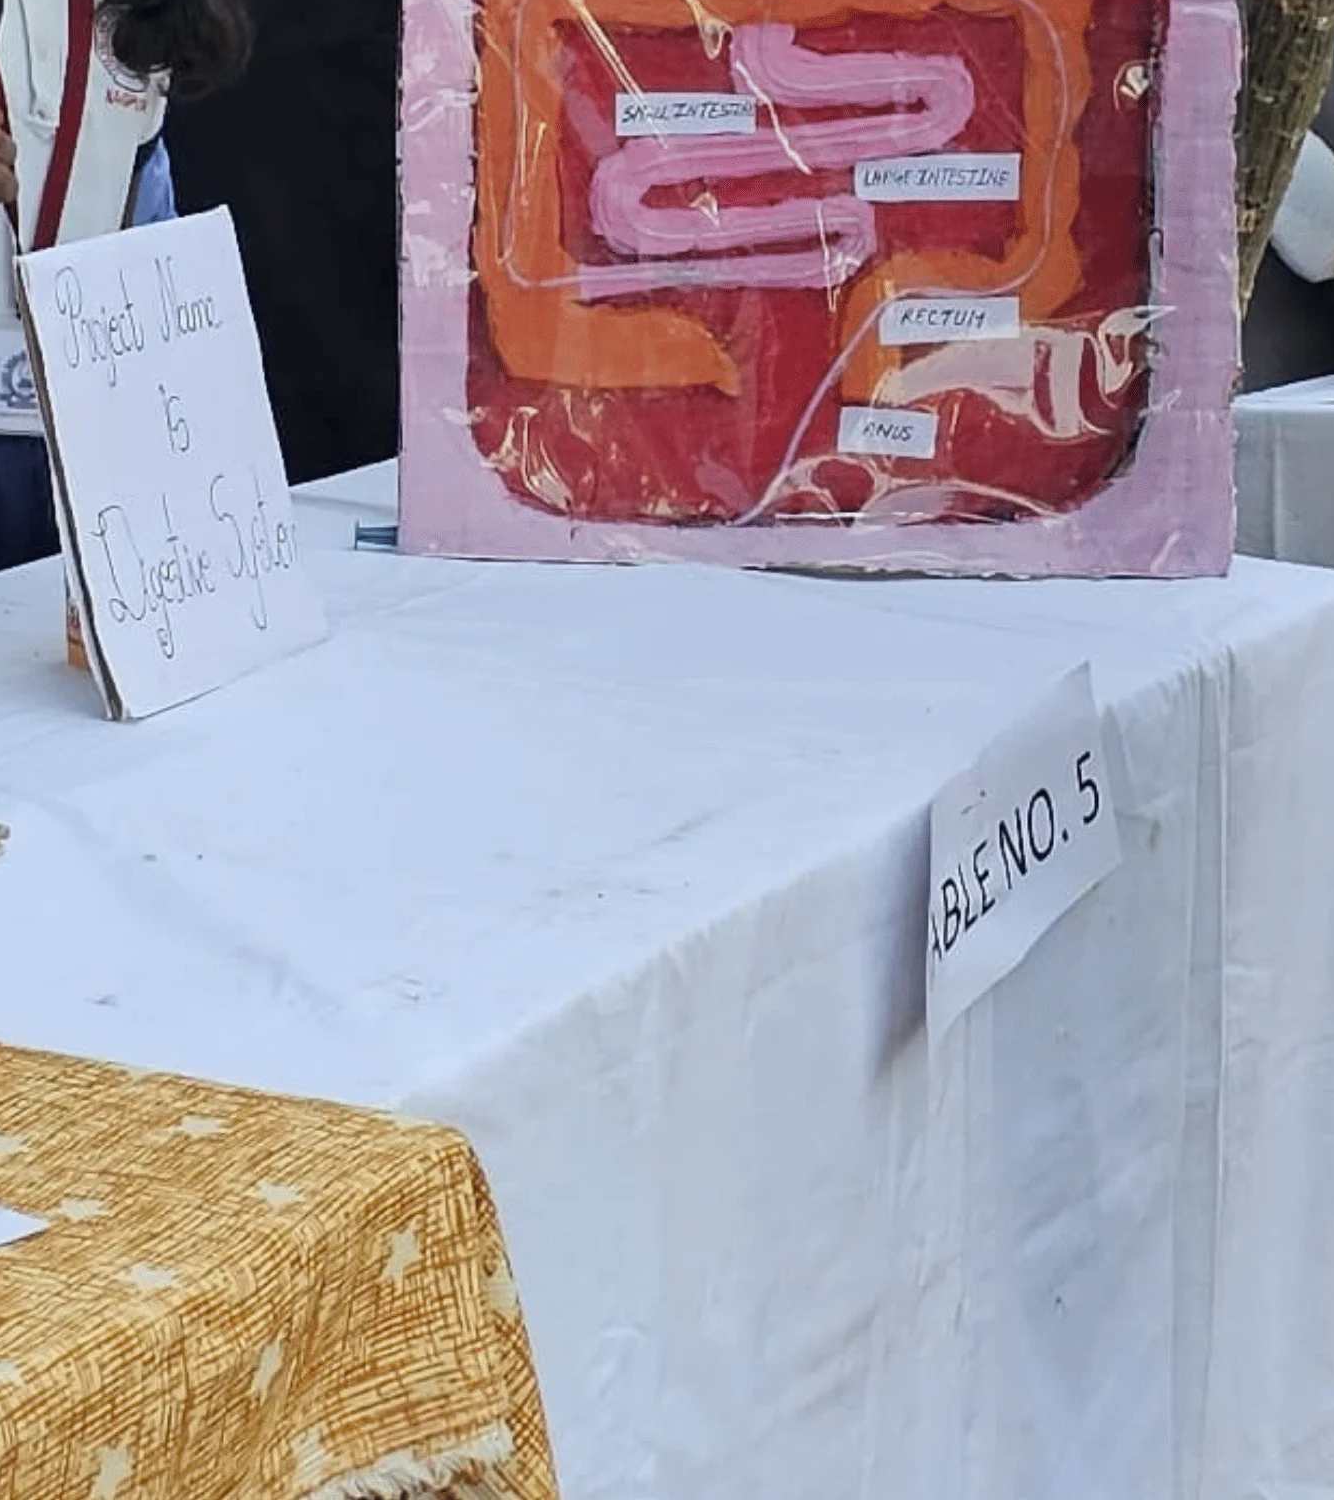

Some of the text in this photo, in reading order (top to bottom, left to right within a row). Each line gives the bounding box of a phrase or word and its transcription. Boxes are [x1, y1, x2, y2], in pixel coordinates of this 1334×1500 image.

[55, 255, 223, 388] Project Name
[899, 306, 986, 329] RECTUM
[862, 419, 916, 442] ANUS
